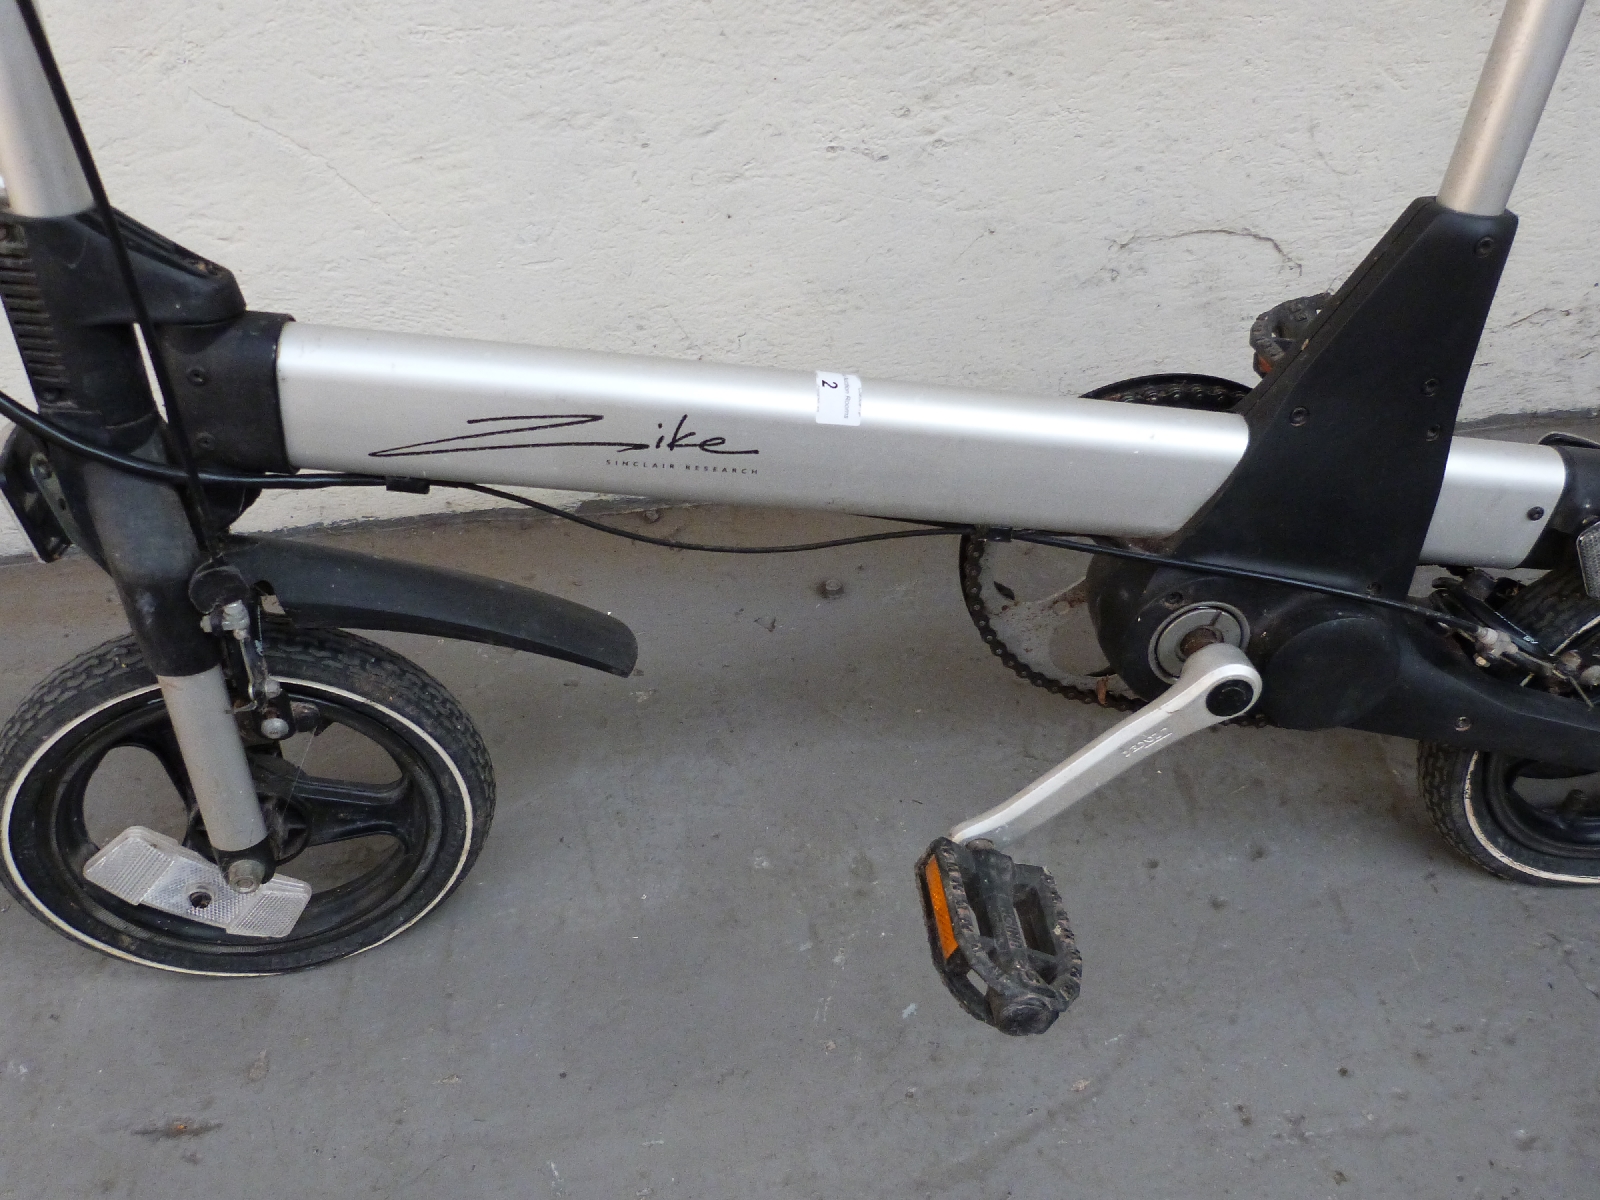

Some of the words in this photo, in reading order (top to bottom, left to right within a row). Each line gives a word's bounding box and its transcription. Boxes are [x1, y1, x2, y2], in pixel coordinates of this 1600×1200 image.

[821, 379, 838, 389] 2
[368, 414, 760, 457] Zike
[606, 459, 675, 469] SINCLAIR
[685, 465, 759, 475] RESEARCH
